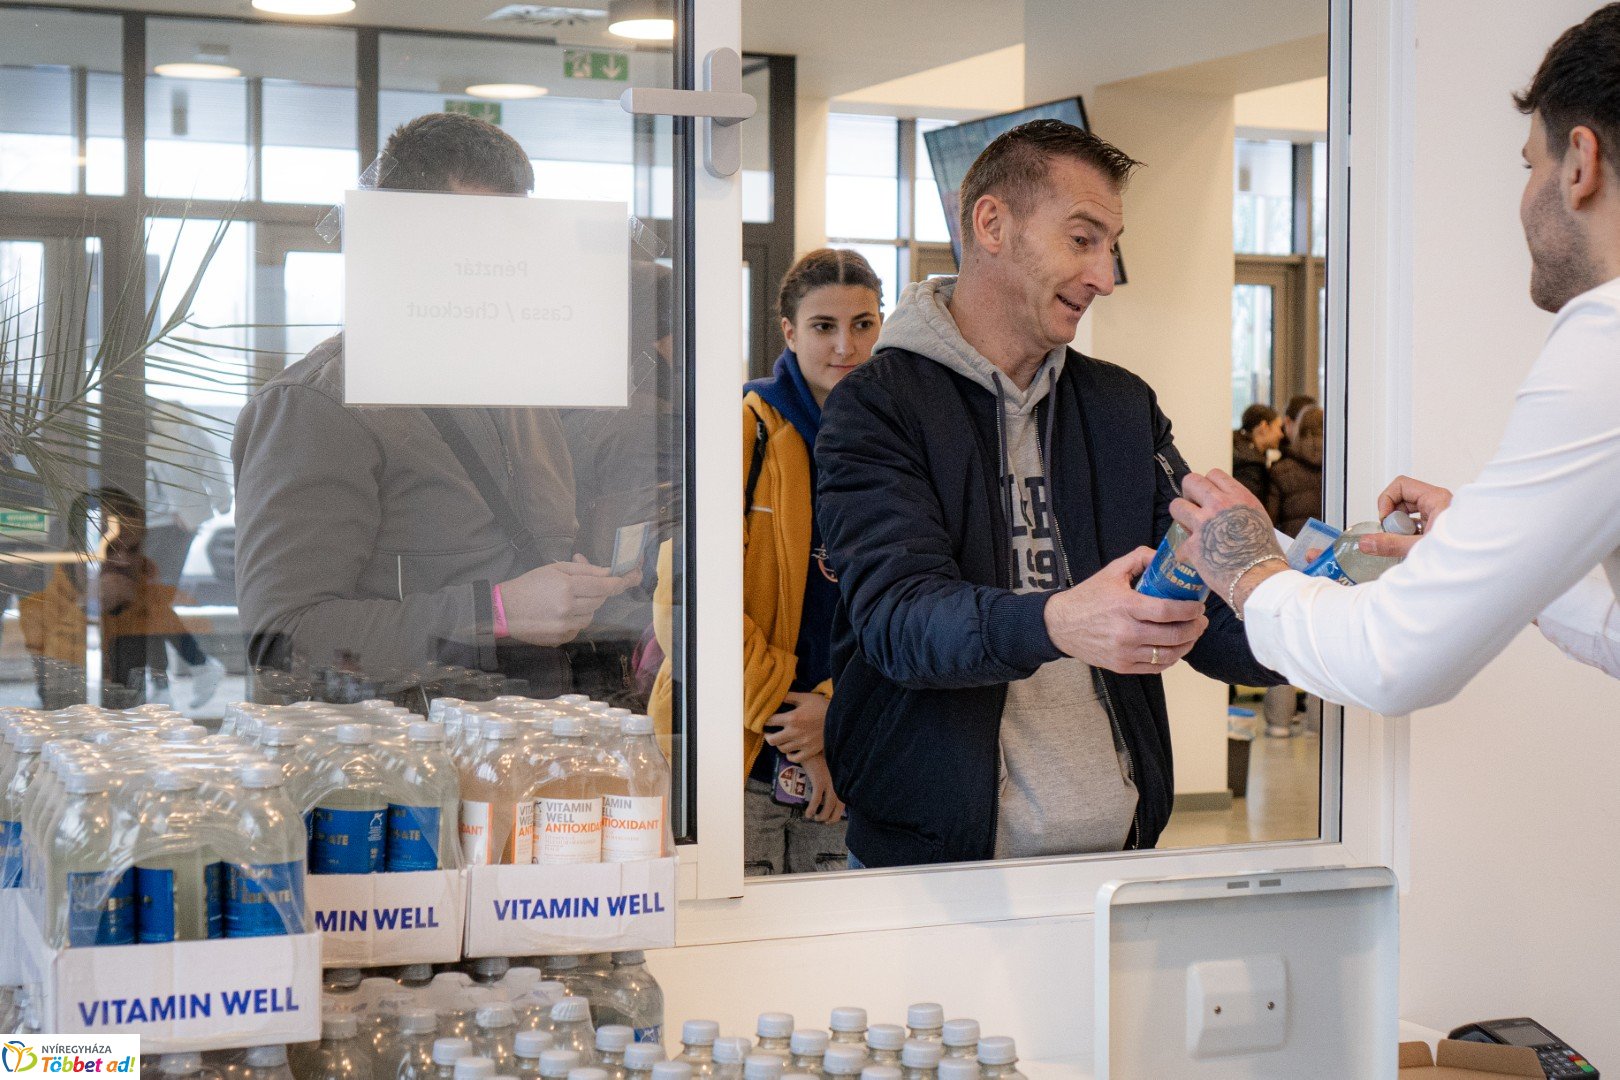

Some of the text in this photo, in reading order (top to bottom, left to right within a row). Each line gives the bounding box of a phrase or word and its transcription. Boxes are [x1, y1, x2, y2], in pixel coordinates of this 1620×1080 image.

[546, 801, 592, 813] VITAMIN
[546, 812, 575, 823] WELL
[373, 906, 439, 931] WELL
[493, 892, 665, 921] VITAMIN WELL
[78, 986, 299, 1027] VITAMIN WELL
